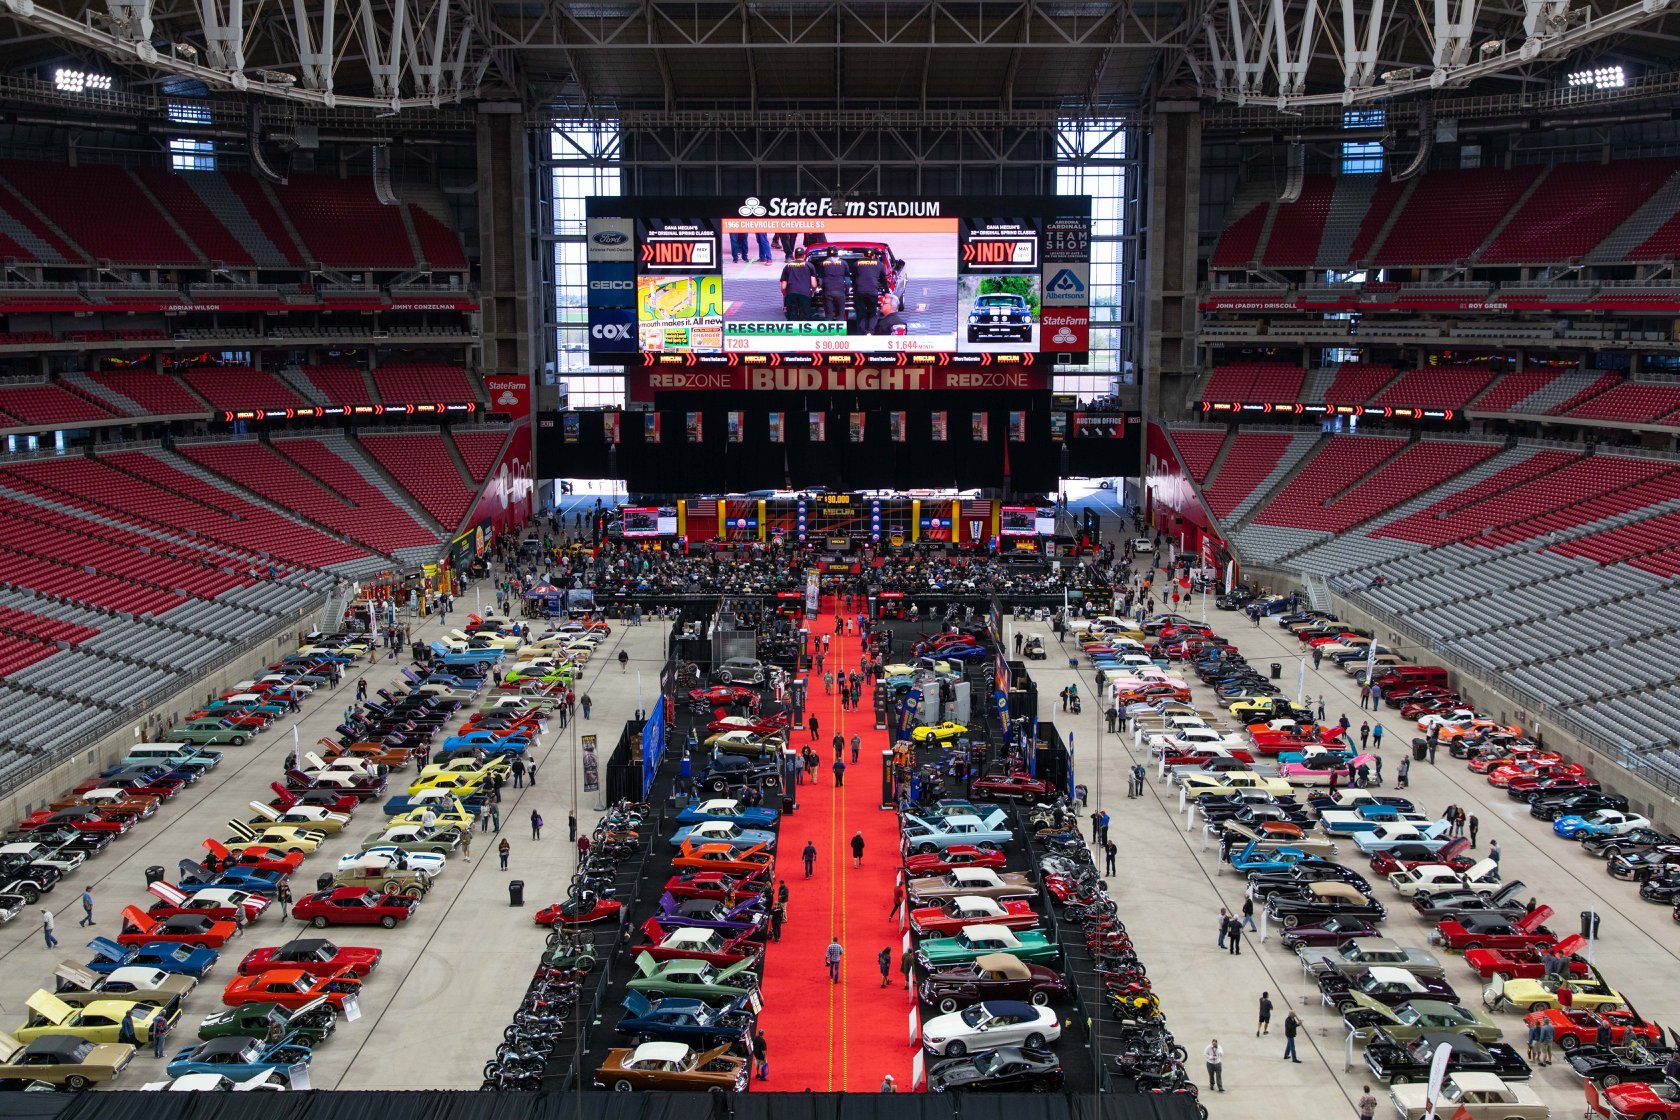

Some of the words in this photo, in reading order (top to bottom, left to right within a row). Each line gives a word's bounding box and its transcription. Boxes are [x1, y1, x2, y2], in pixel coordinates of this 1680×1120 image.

[769, 198, 864, 216] StateFm
[868, 202, 940, 216] STADIUM
[600, 233, 621, 243] Ford
[1046, 232, 1087, 240] TEAM
[1046, 241, 1087, 249] SHOP
[656, 243, 694, 262] INDY
[977, 243, 1016, 262] INDY
[590, 281, 633, 290] GEICO
[592, 322, 632, 341] COX
[728, 323, 792, 334] RESERVE
[800, 323, 812, 334] IS
[817, 323, 844, 334] OFF
[727, 339, 749, 349] T203
[823, 341, 850, 350] 90,000
[895, 341, 917, 350] 1,644
[650, 374, 731, 387] REDZONE
[752, 368, 822, 390] BUD
[828, 368, 925, 390] LIGHT
[947, 374, 1028, 387] REDZONE
